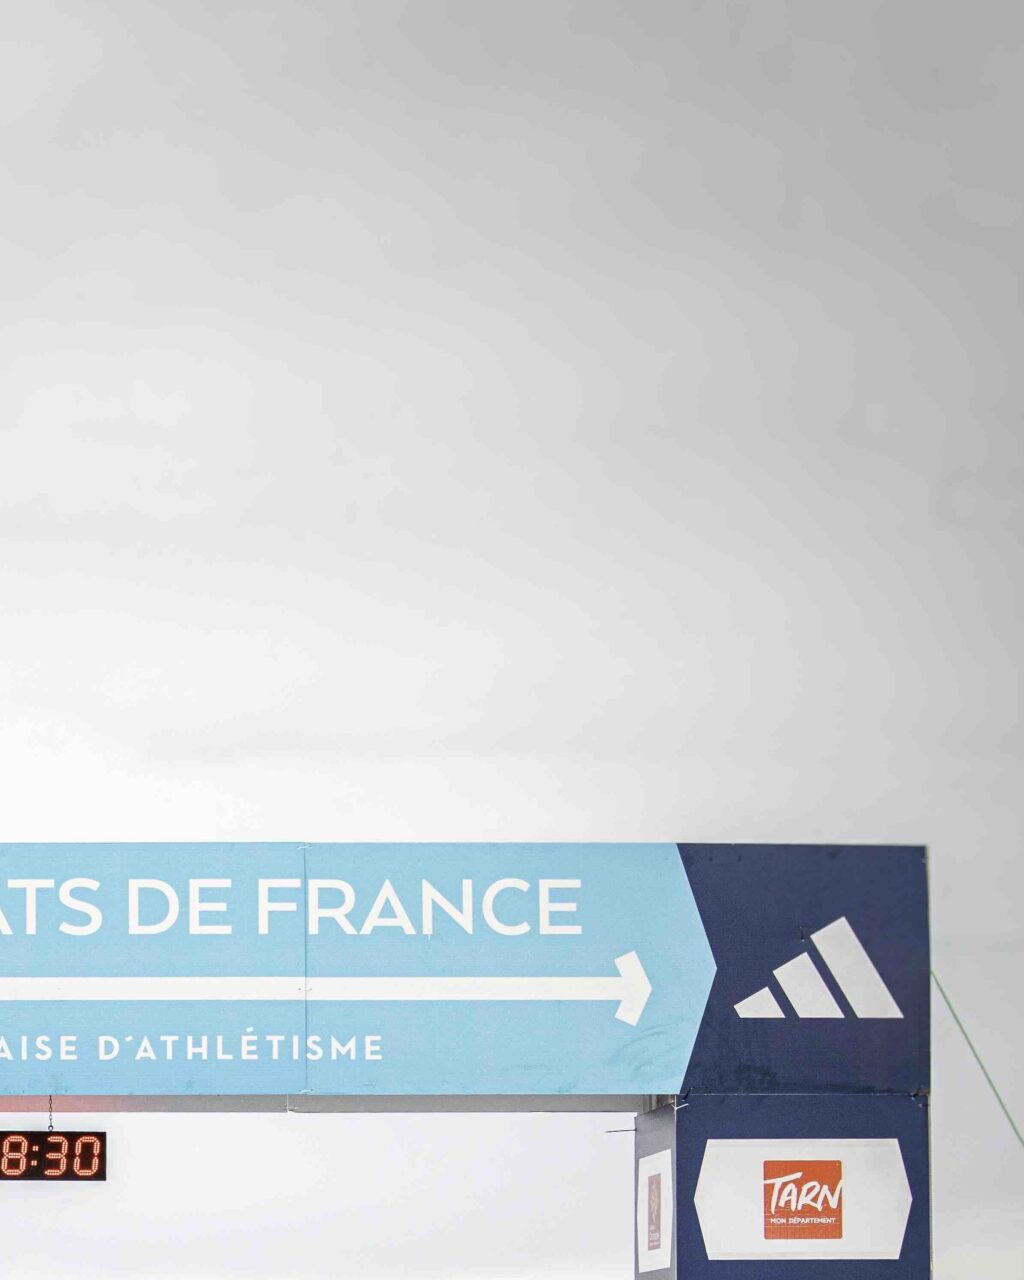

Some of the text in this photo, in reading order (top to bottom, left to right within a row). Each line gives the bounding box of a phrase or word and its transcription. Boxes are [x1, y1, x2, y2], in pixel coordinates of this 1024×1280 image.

[128, 877, 233, 936] DE
[257, 877, 582, 937] FRANCE
[98, 1026, 384, 1061] D'ATHLÉTISME
[764, 1171, 844, 1215] TARN
[788, 1215, 836, 1224] DÉPARTEMENT
